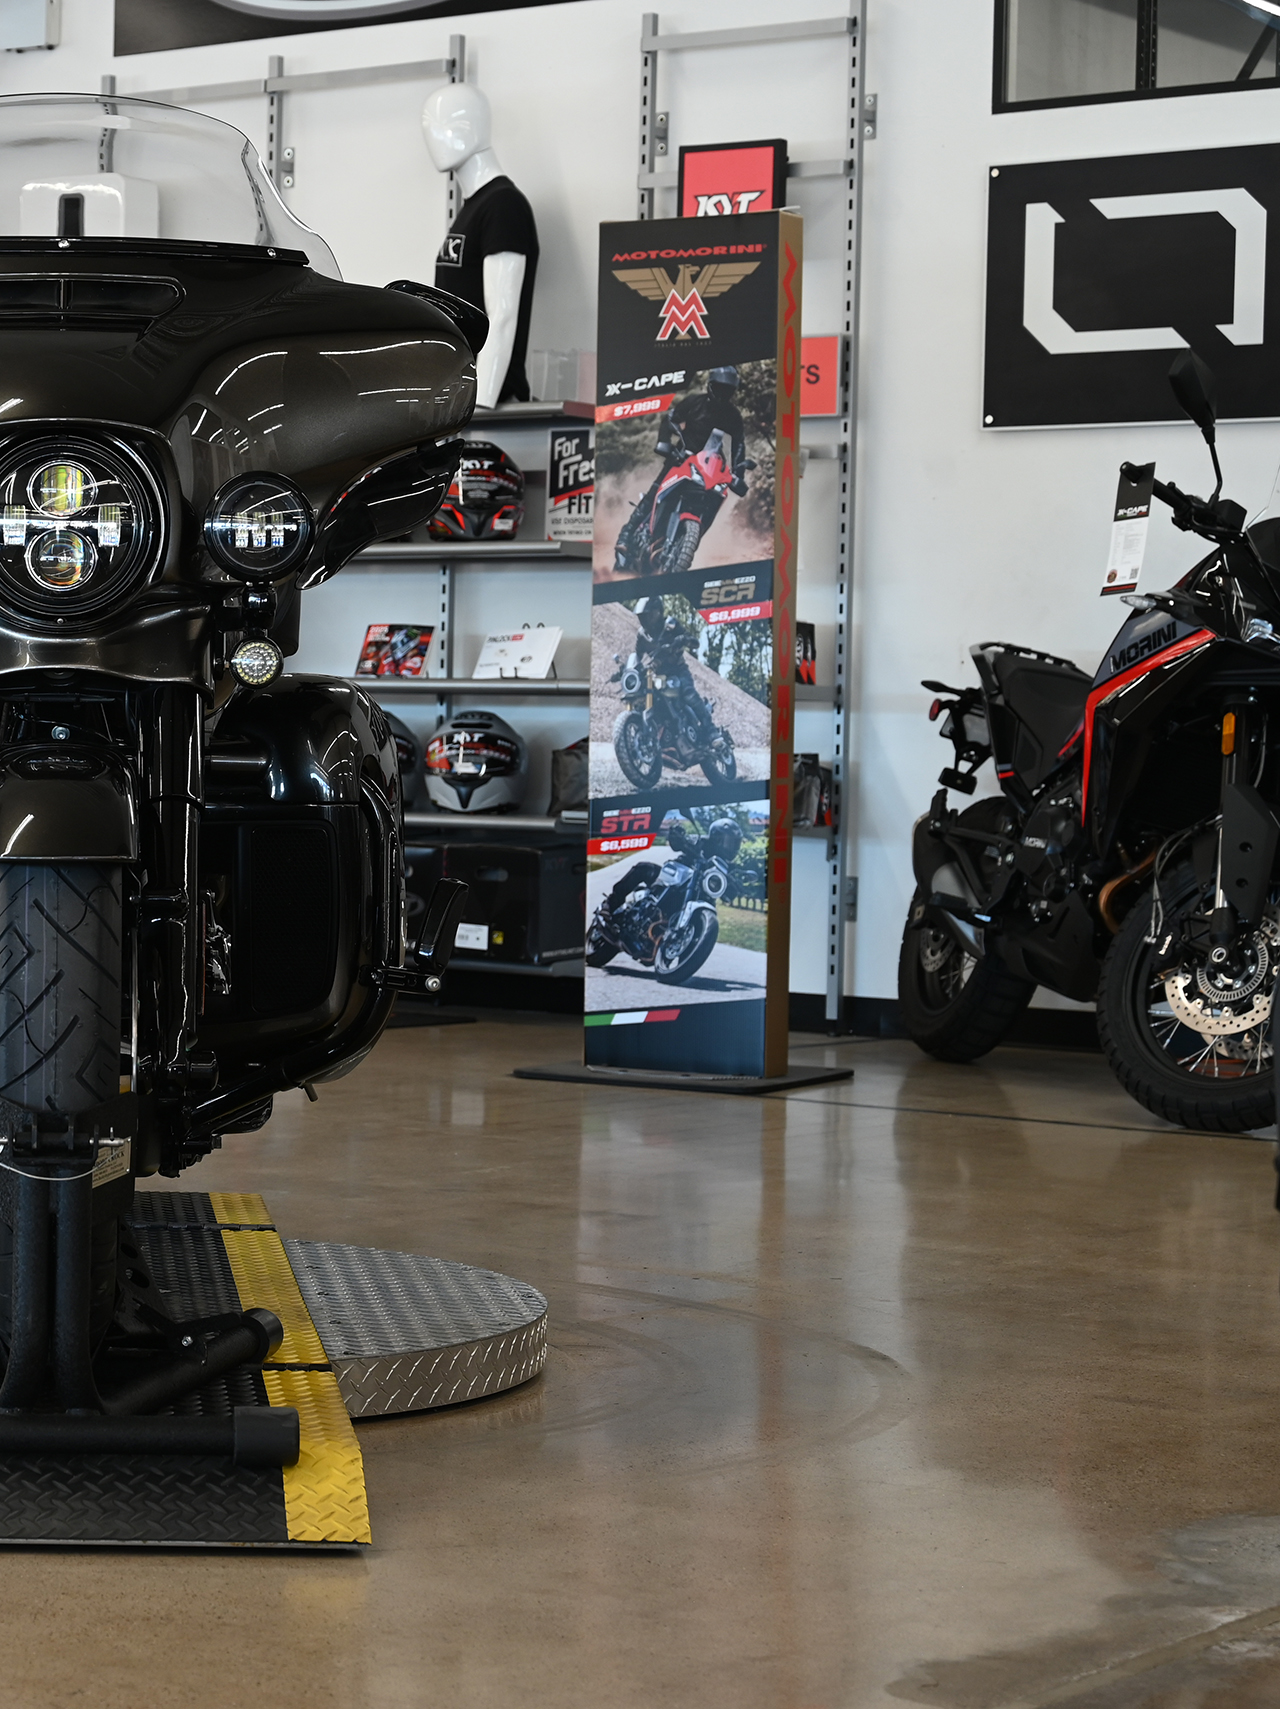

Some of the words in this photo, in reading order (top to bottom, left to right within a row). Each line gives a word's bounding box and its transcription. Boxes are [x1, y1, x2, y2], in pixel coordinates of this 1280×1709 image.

[605, 370, 686, 397] X-CAPE
[613, 400, 661, 417] $7,999
[554, 436, 580, 460] For
[462, 459, 494, 470] KYT
[568, 494, 593, 514] FIT
[1110, 620, 1177, 673] MORINI
[601, 814, 651, 834] STR
